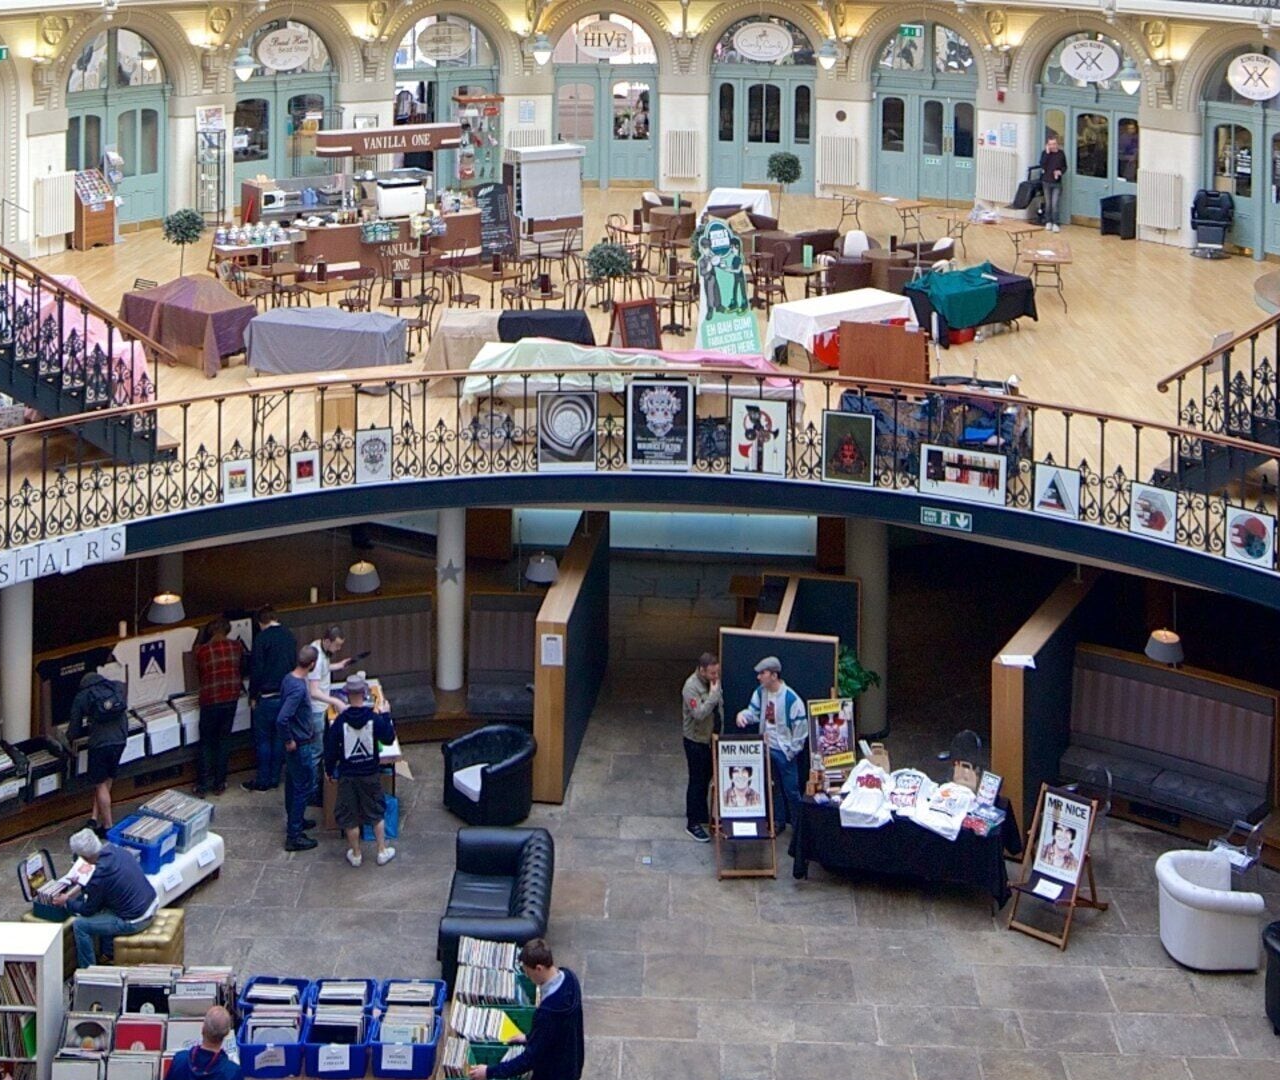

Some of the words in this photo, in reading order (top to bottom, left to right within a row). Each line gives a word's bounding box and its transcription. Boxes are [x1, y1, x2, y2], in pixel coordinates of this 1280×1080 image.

[583, 30, 628, 48] HIVE
[363, 134, 407, 149] VANILLA
[411, 132, 432, 147] ONE
[379, 241, 415, 258] VANILL
[721, 744, 737, 755] MR
[739, 743, 761, 755] NICE
[1047, 796, 1063, 811] MR
[1065, 802, 1088, 820] NICE
